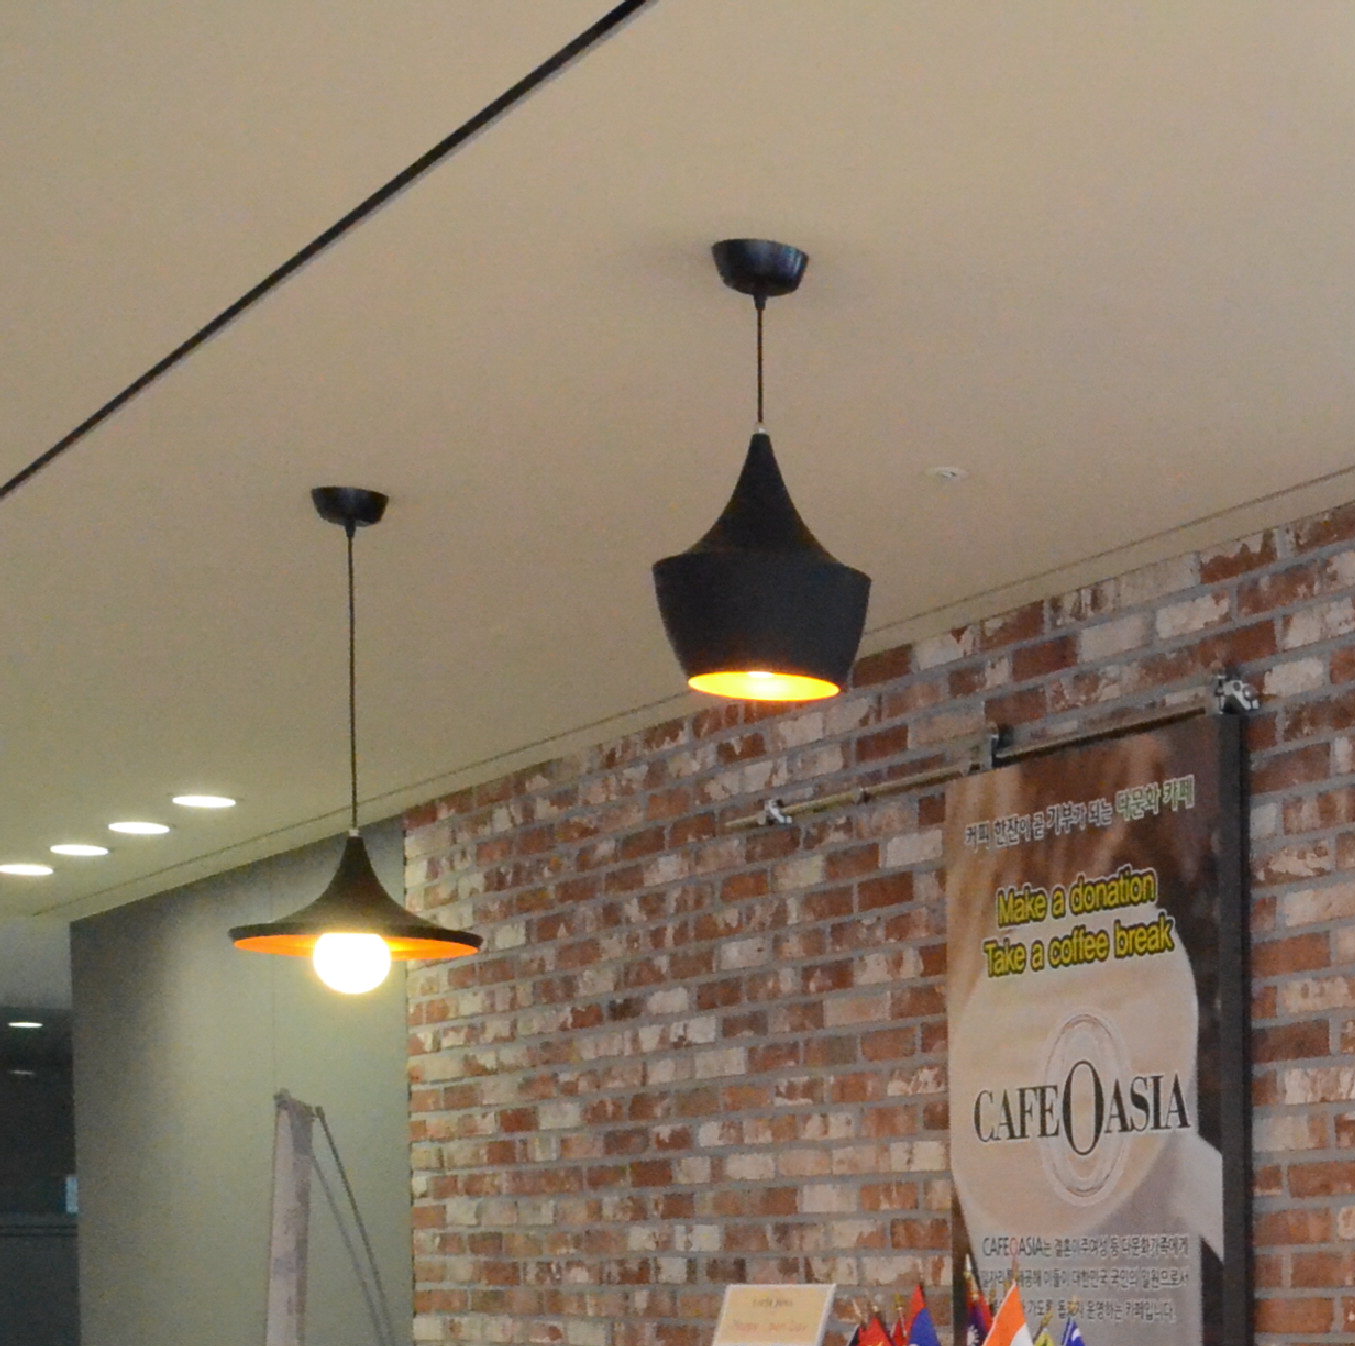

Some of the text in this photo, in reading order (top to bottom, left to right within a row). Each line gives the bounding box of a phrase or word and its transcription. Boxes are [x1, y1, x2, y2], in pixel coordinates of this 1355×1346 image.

[965, 821, 990, 854] 커피
[1087, 797, 1113, 828] 되는
[1115, 781, 1160, 821] 다문화
[1162, 774, 1195, 812] 카페
[997, 867, 1157, 928] Make a donation
[984, 910, 1175, 977] Take a coffee break
[1122, 1235, 1189, 1258] 다문화가족에게
